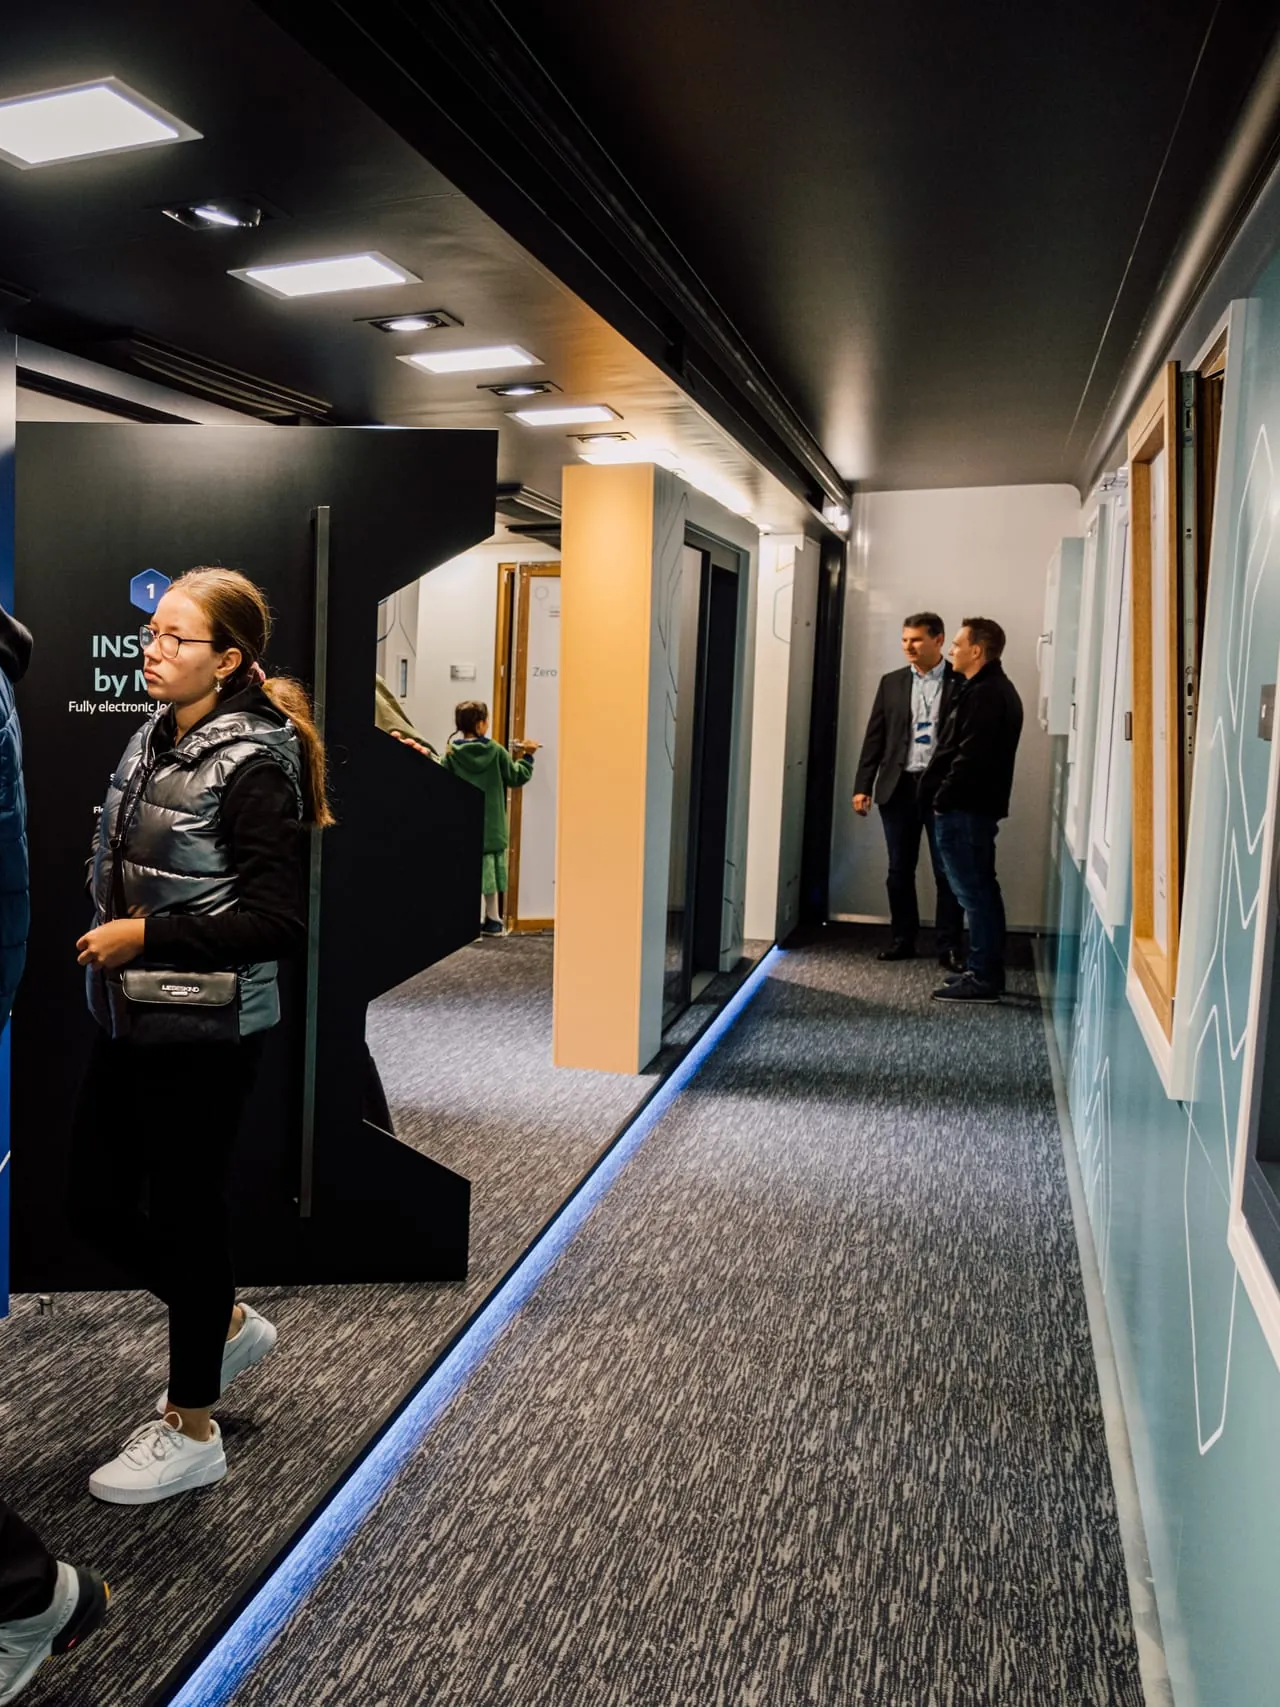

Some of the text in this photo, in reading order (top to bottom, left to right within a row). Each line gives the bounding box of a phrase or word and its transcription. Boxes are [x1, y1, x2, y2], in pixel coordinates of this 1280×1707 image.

[146, 583, 155, 600] 1
[92, 634, 140, 659] INS
[533, 667, 558, 678] Zero
[94, 667, 128, 698] by
[68, 700, 97, 715] Fully
[98, 700, 154, 713] electronic
